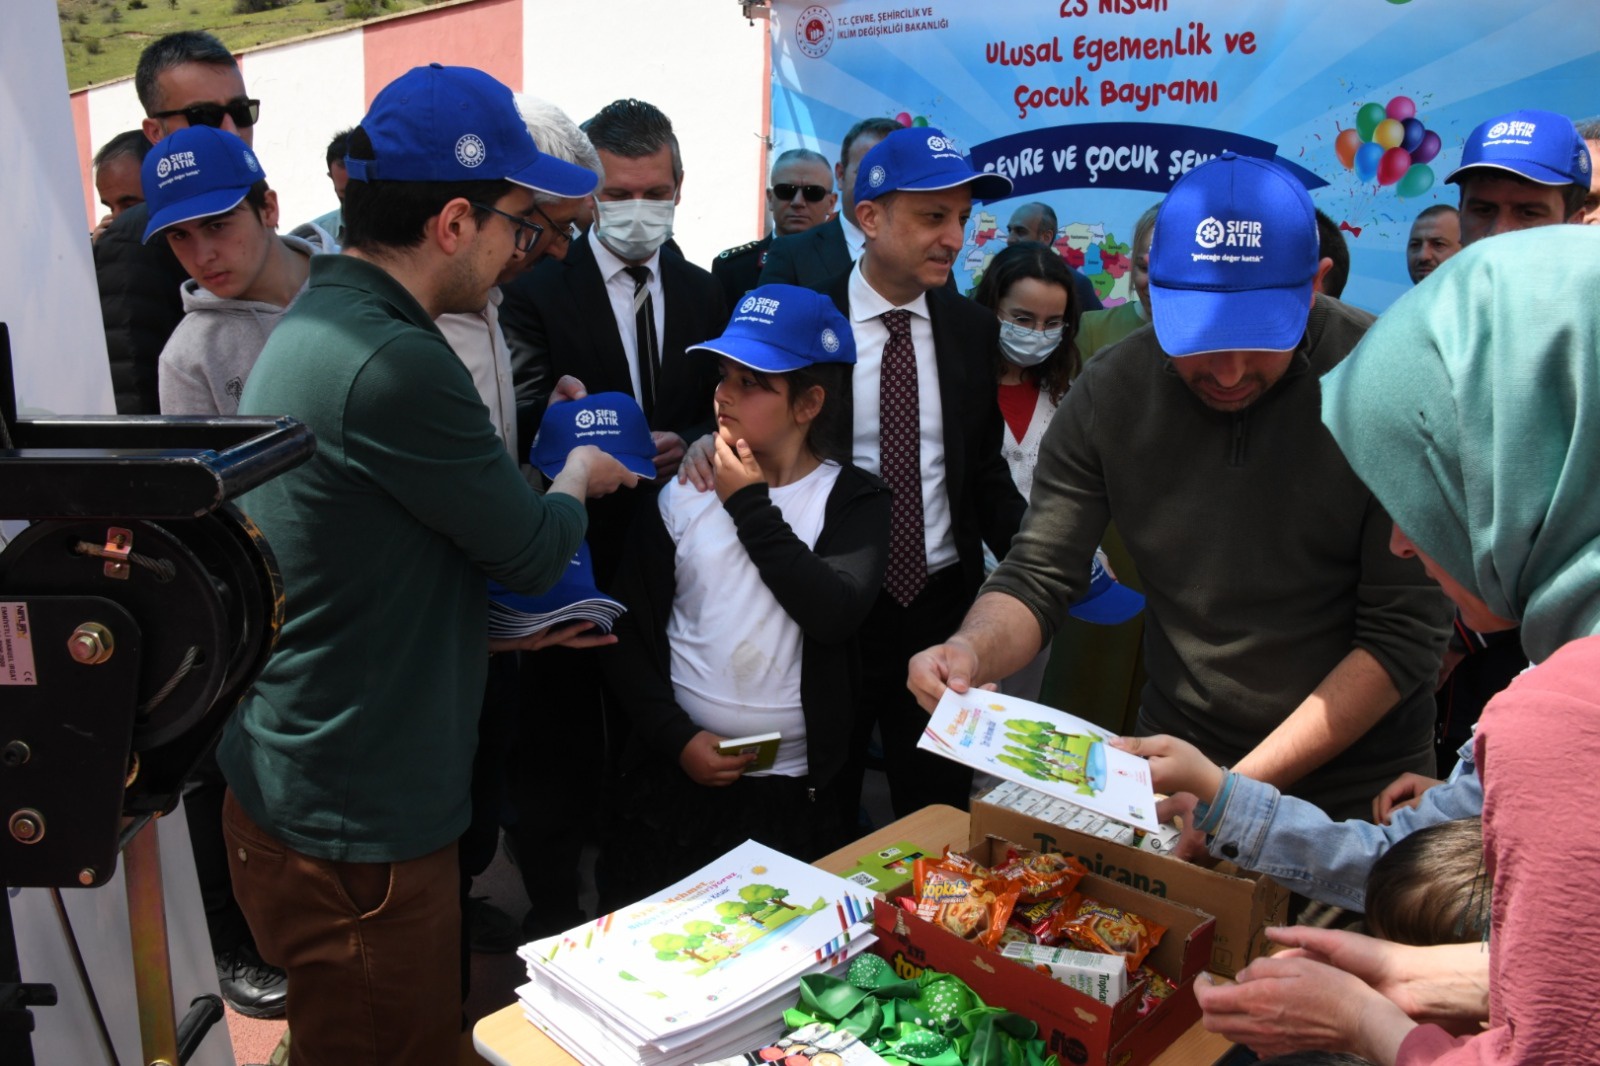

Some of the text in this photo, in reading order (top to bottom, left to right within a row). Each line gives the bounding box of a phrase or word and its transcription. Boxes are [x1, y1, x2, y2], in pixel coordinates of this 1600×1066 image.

[838, 7, 932, 26] T.C. ÇEVRE, ŞEHİRCİLİK VE
[837, 19, 949, 39] İKLİM DEĞİŞİKLİĞİ BAKANLIĞI
[1224, 30, 1257, 55] ve
[1014, 76, 1218, 119] Çocuk Bayramı
[169, 151, 195, 163] SIFIR
[1051, 145, 1077, 173] VE
[1085, 145, 1160, 183] ÇOCUK
[173, 158, 197, 171] ATIK
[1226, 220, 1262, 234] SIFIR
[1225, 233, 1262, 248] ATIK
[753, 304, 778, 316] ATIK
[756, 297, 780, 309] SIFIR
[595, 409, 617, 418] SIFIR
[597, 417, 619, 426] ATIK
